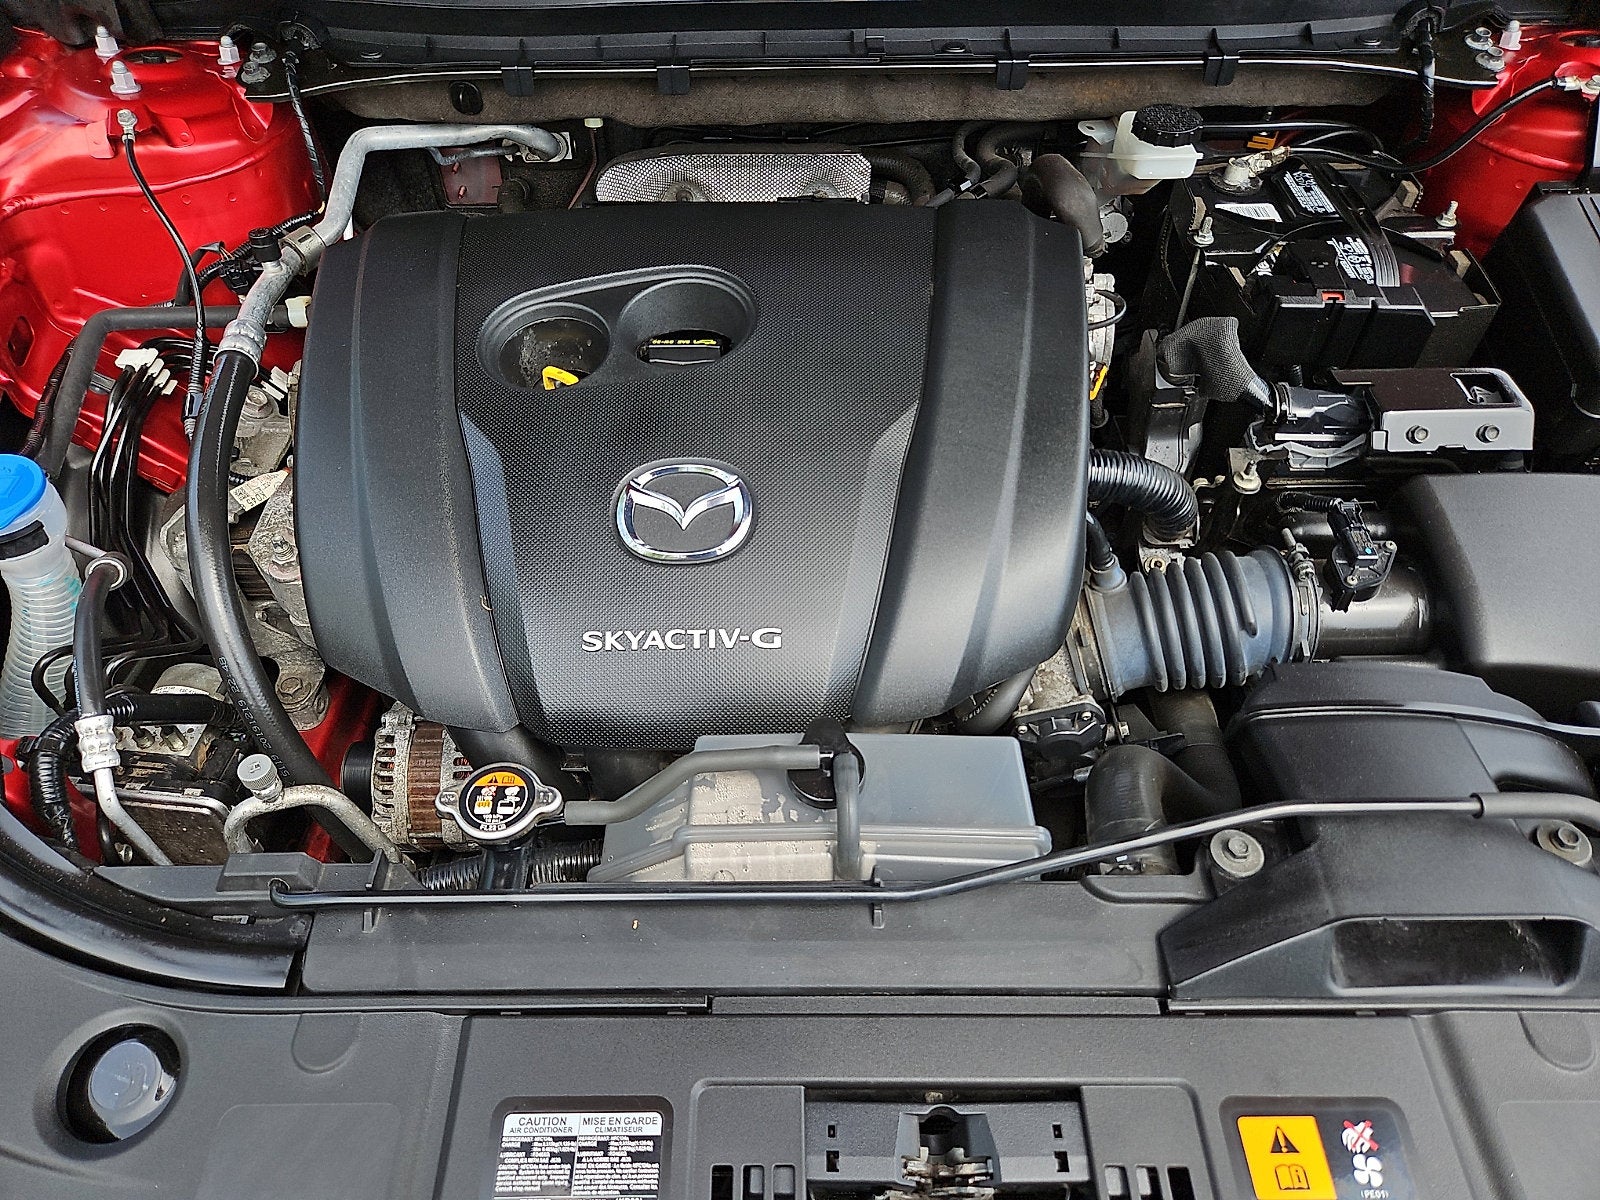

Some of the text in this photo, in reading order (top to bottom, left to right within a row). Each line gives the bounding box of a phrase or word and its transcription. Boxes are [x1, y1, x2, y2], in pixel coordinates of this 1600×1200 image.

[581, 627, 782, 652] SKYACTIV-G
[237, 698, 272, 751] 20191219
[518, 1117, 567, 1126] CAUTION
[582, 1117, 658, 1126] MISE EN GARDE
